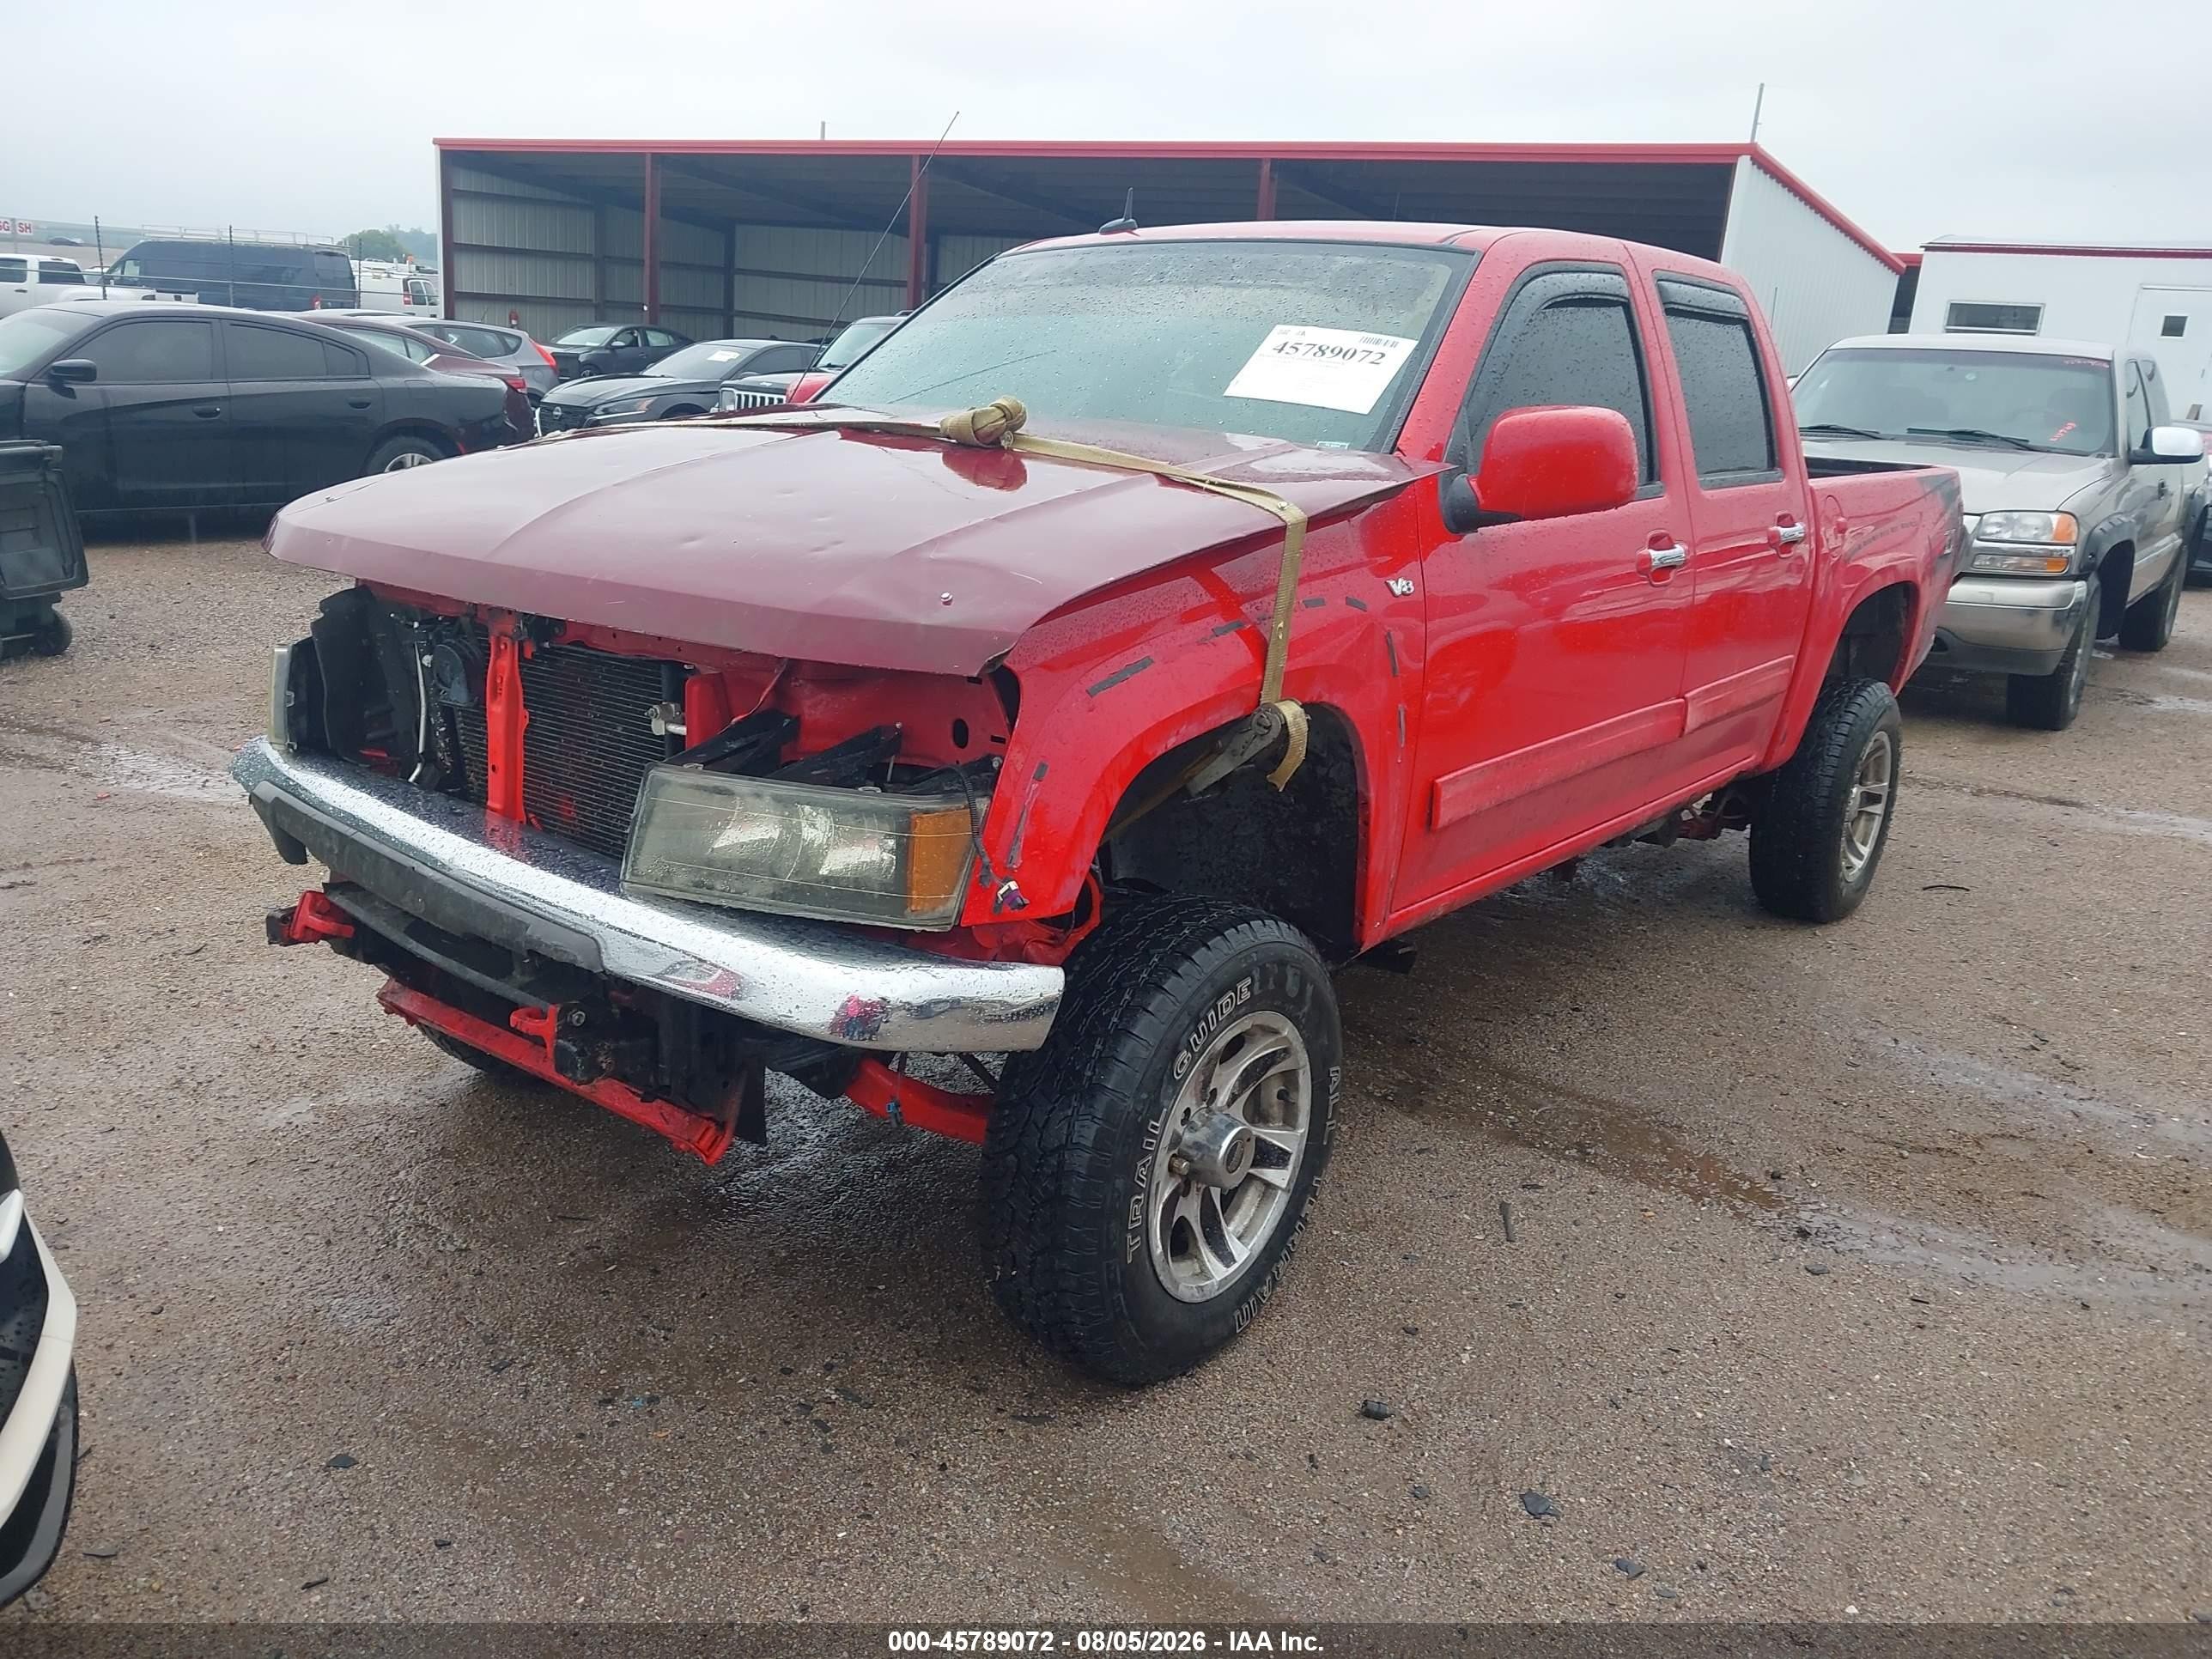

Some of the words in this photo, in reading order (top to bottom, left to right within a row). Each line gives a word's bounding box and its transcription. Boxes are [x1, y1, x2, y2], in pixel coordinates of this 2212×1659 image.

[18, 222, 32, 234] SH
[1273, 341, 1386, 366] 45789072
[1384, 576, 1415, 598] V8
[1126, 1108, 1167, 1265] TRAIL
[1173, 975, 1252, 1080] GUIDE
